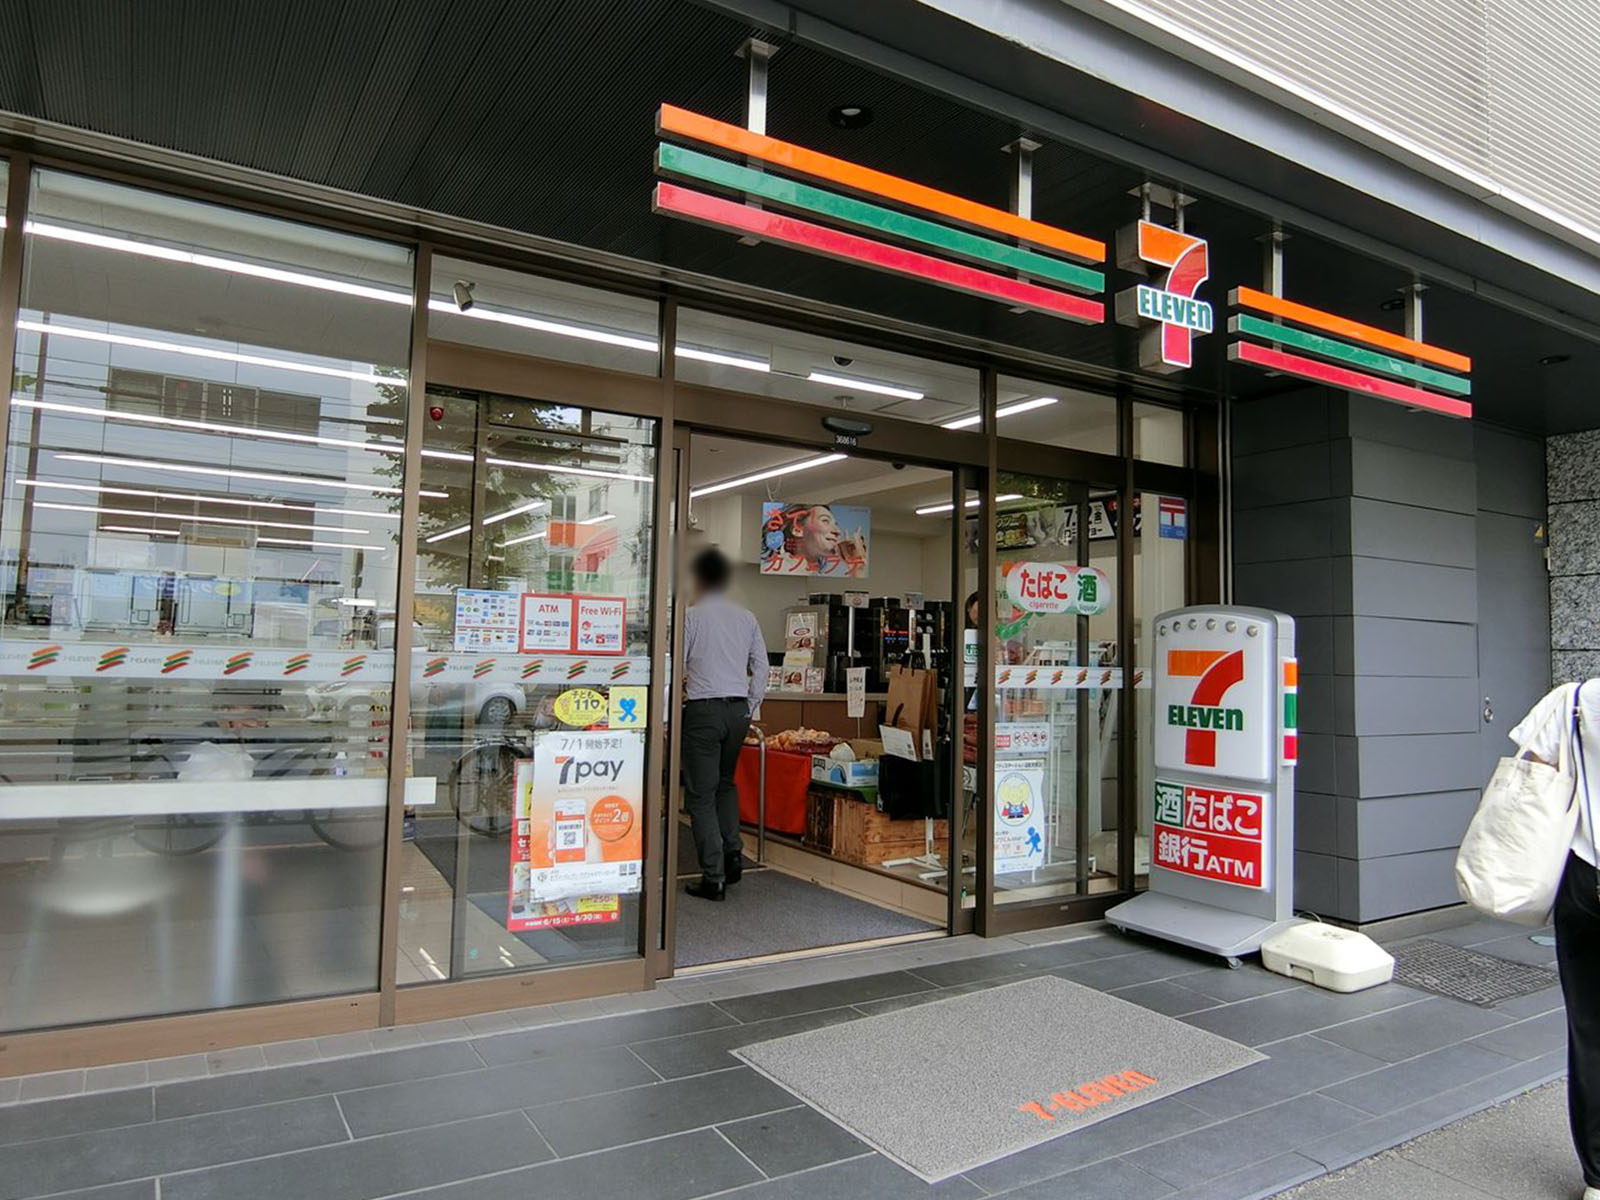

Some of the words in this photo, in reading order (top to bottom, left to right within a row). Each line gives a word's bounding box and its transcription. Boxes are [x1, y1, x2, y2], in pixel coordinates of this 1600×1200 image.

[1138, 219, 1208, 369] 7
[764, 551, 865, 576] カフェラテ
[1020, 568, 1068, 600] たばこ
[1077, 573, 1098, 603] 酒
[538, 603, 559, 614] ATM
[580, 606, 598, 616] Free
[600, 606, 622, 617] Wi-Fi
[1028, 600, 1060, 610] cigarette
[571, 690, 594, 699] 子ども
[1167, 649, 1244, 768] 7
[1155, 784, 1183, 826] 酒
[1186, 791, 1260, 836] たばこ
